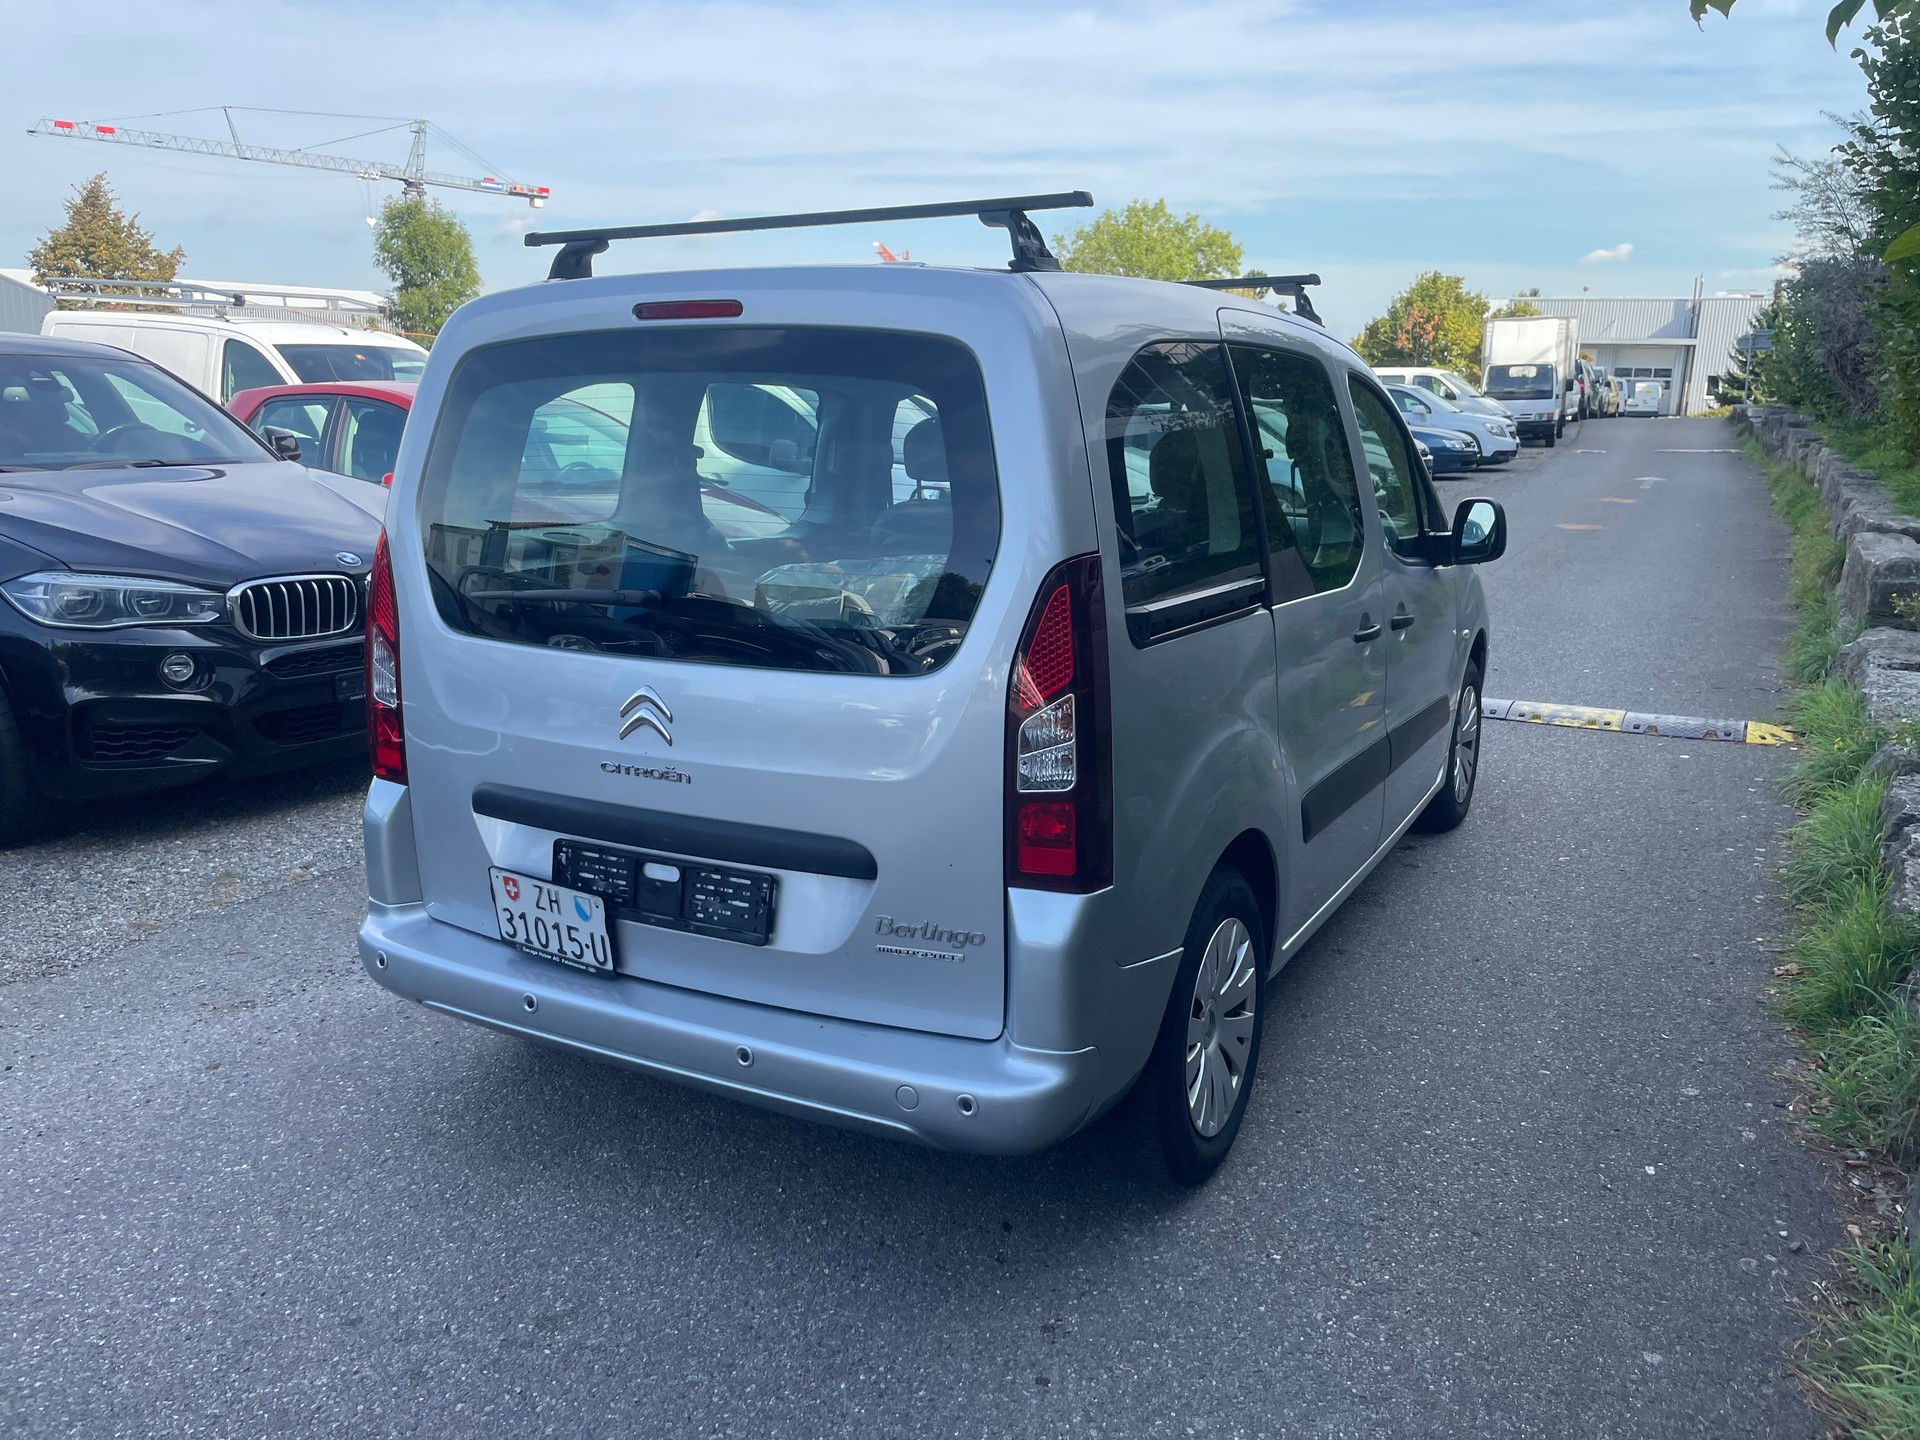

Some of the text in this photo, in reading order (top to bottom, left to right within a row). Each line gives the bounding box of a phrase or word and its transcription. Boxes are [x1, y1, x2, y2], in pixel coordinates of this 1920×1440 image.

[531, 884, 561, 915] ZH
[875, 914, 986, 949] Berlingo
[522, 946, 538, 955] Garage
[552, 954, 560, 963] AG
